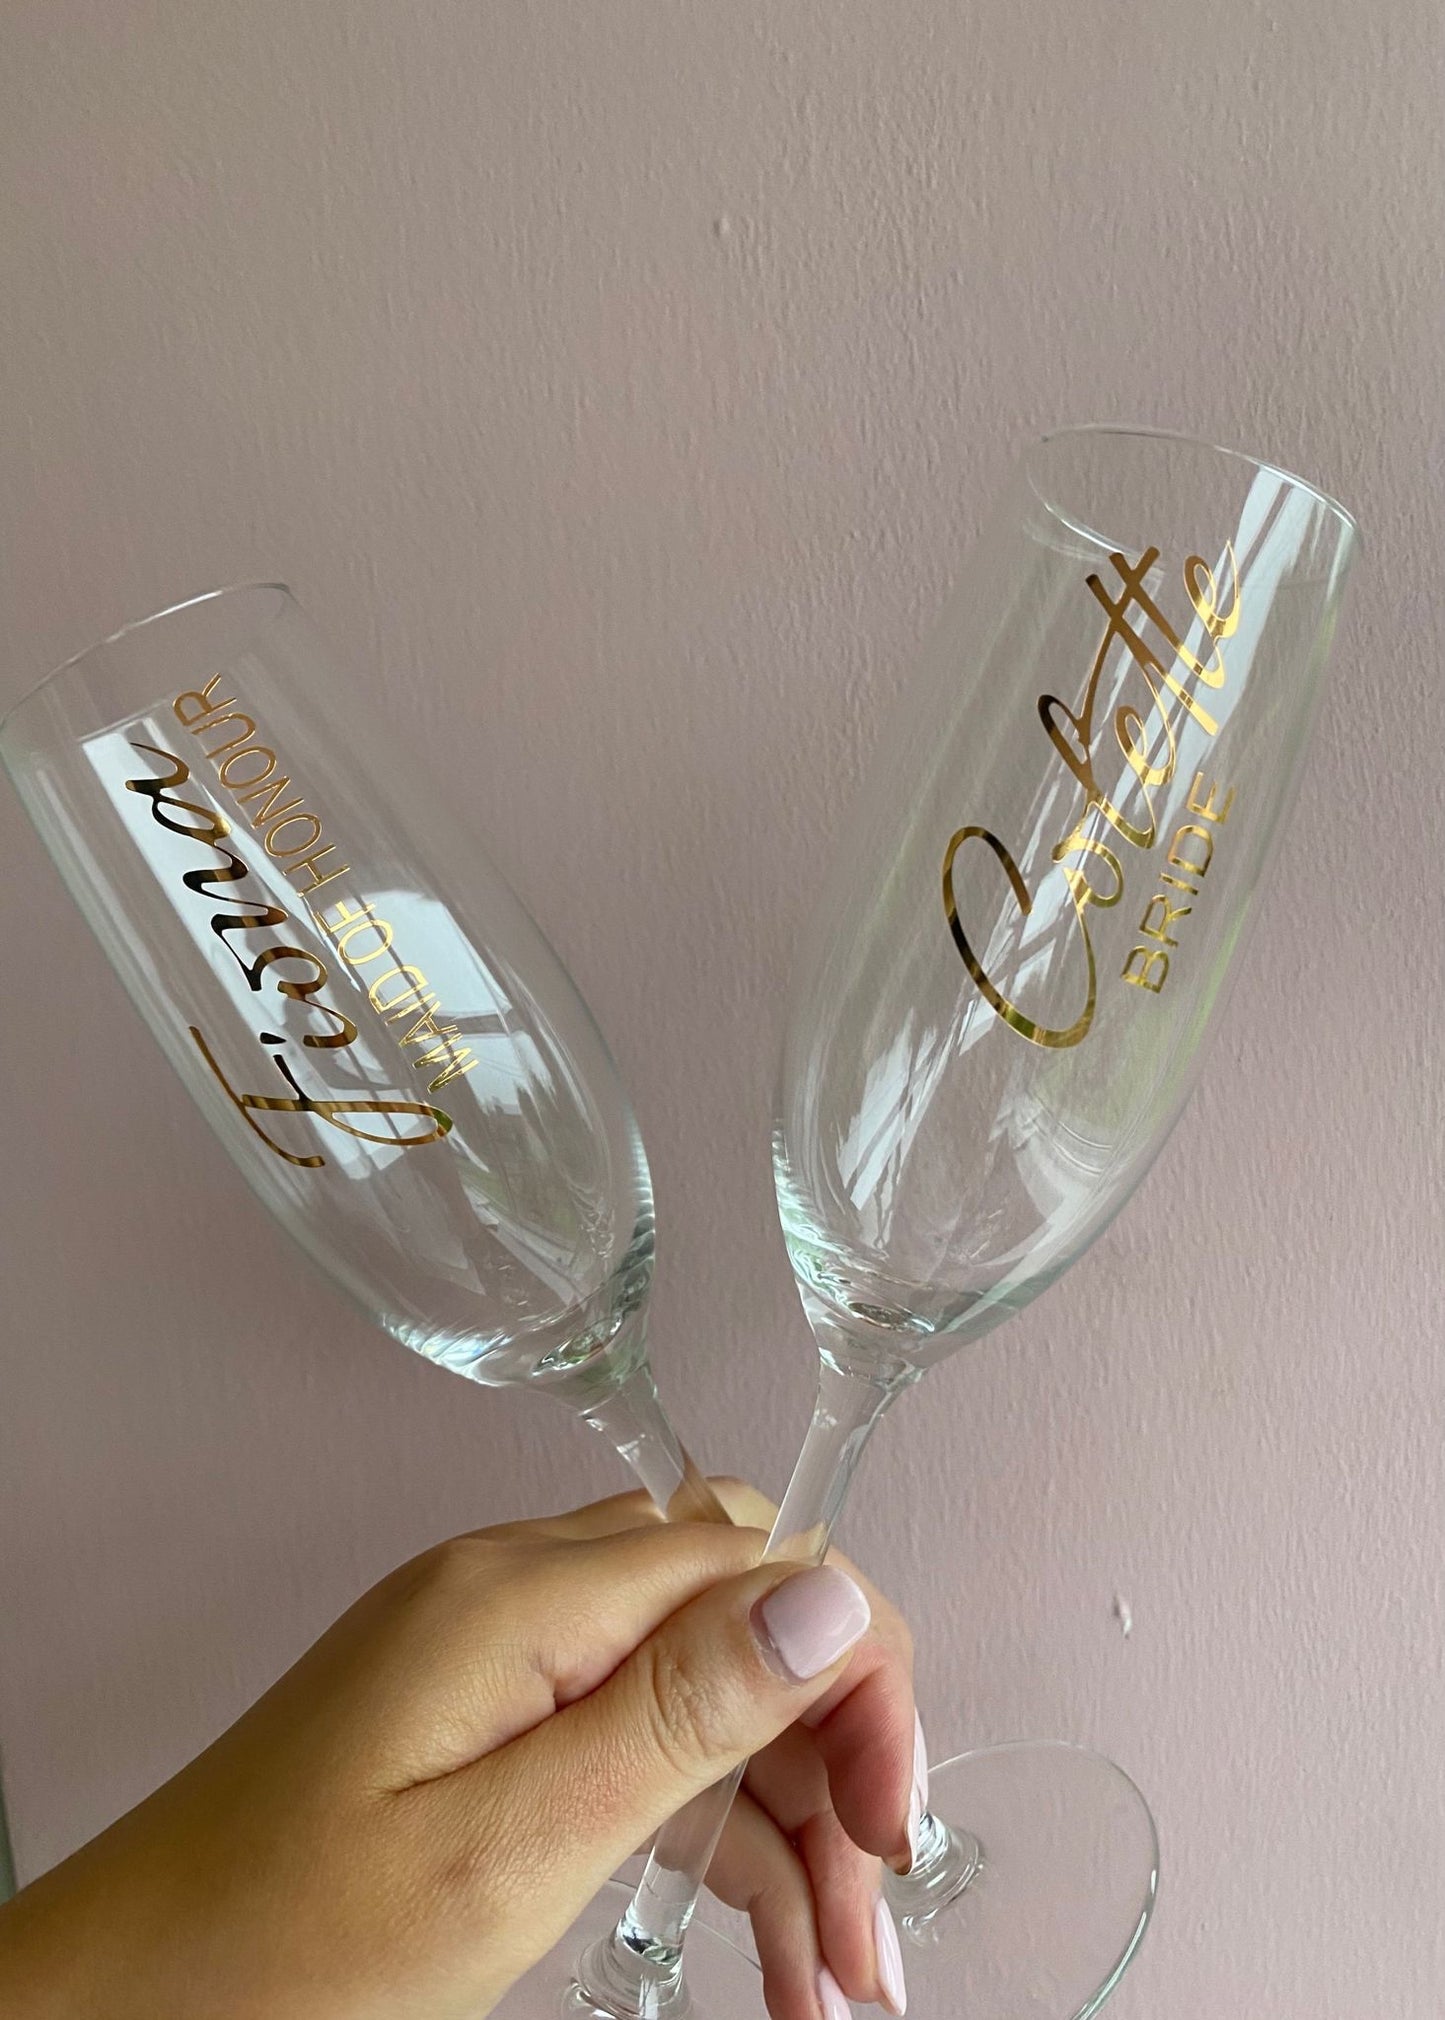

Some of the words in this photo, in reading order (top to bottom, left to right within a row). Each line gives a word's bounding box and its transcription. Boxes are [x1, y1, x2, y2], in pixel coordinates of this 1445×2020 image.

[172, 672, 351, 897] HONOUR
[942, 538, 1241, 1049] Colette
[1120, 771, 1236, 994] BRIDE
[125, 742, 453, 1168] Fiona
[313, 900, 396, 966] OF
[368, 964, 479, 1094] MAID
